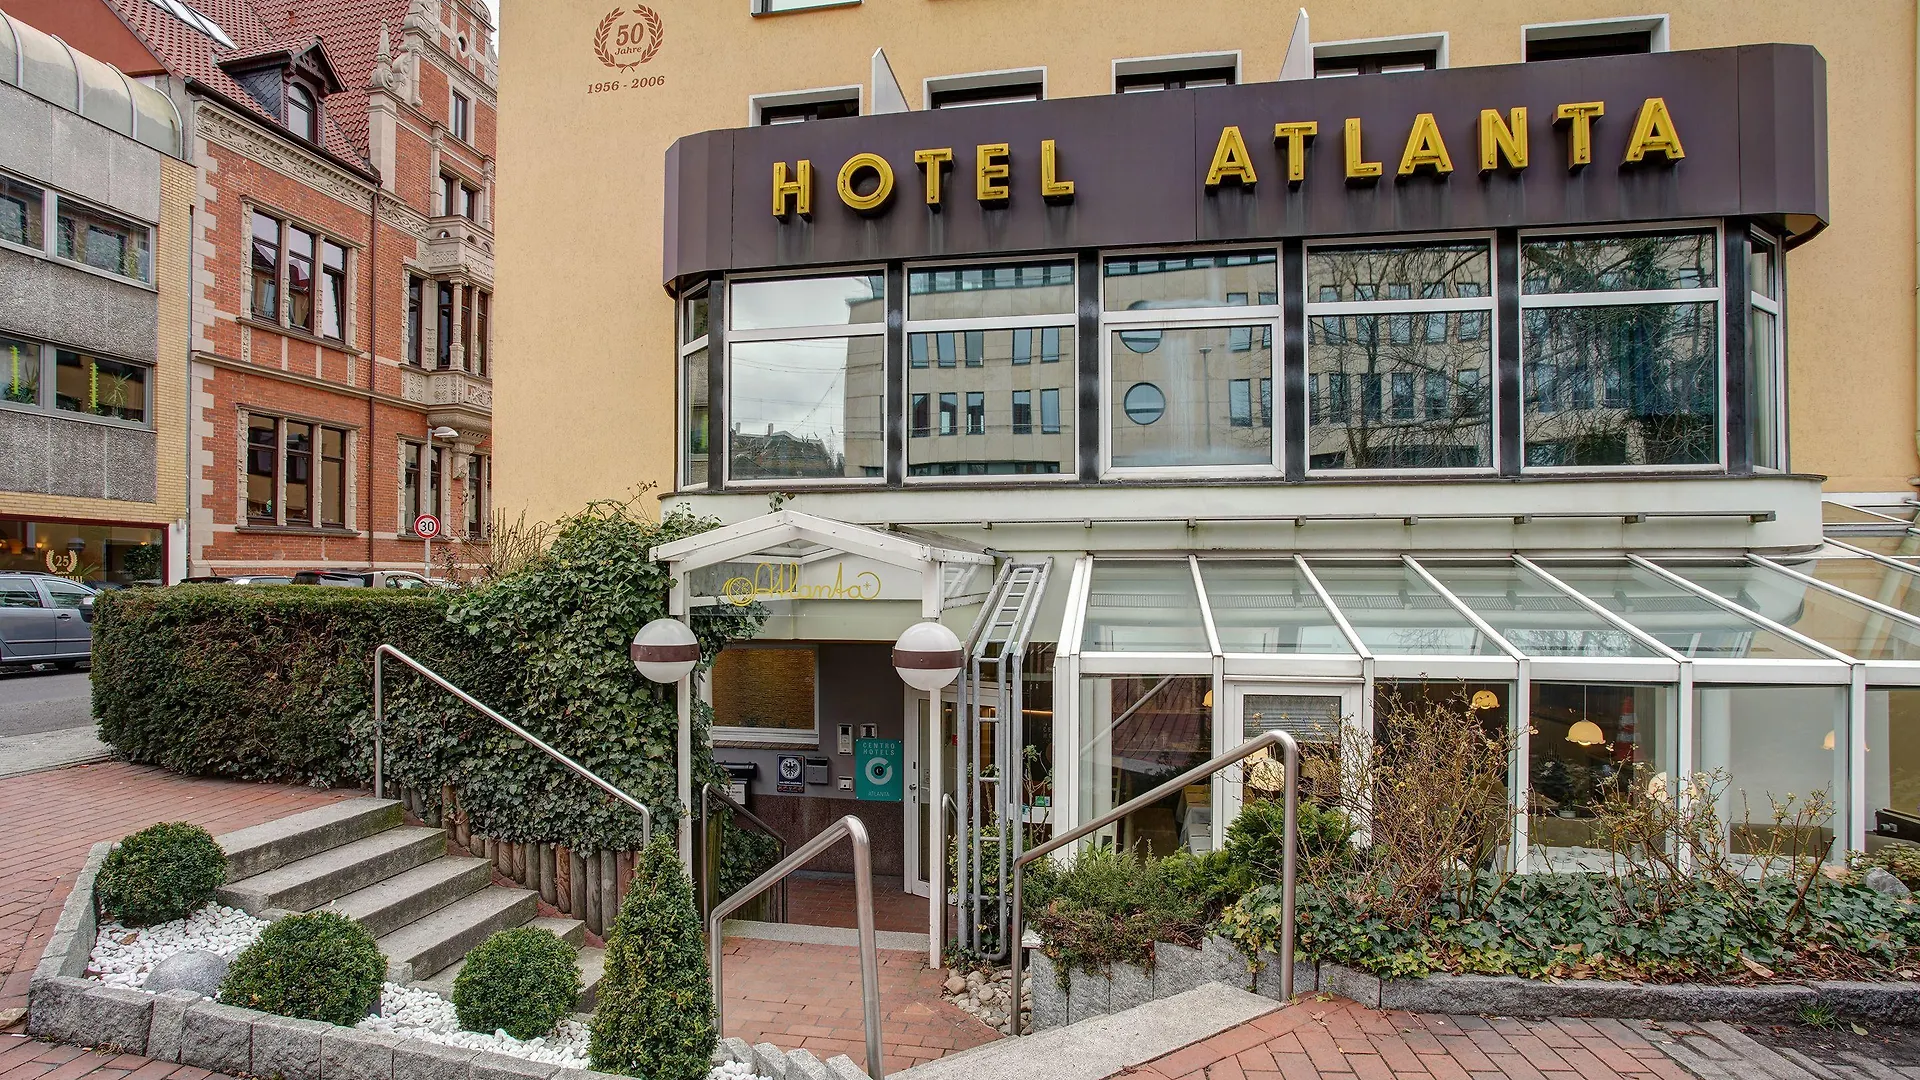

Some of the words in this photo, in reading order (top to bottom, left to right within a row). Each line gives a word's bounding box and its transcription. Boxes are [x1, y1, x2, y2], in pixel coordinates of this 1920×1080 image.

[615, 22, 645, 47] 50
[614, 46, 642, 56] Jahre
[587, 80, 620, 94] 1956
[631, 75, 665, 89] 2006
[773, 140, 1076, 220] HOTEL
[1204, 97, 1687, 190] ATLANTA
[420, 520, 435, 532] 30
[55, 555, 70, 567] 25
[752, 562, 881, 600] Atlanta
[862, 742, 895, 750] CENTRO
[862, 748, 895, 756] HOTELS
